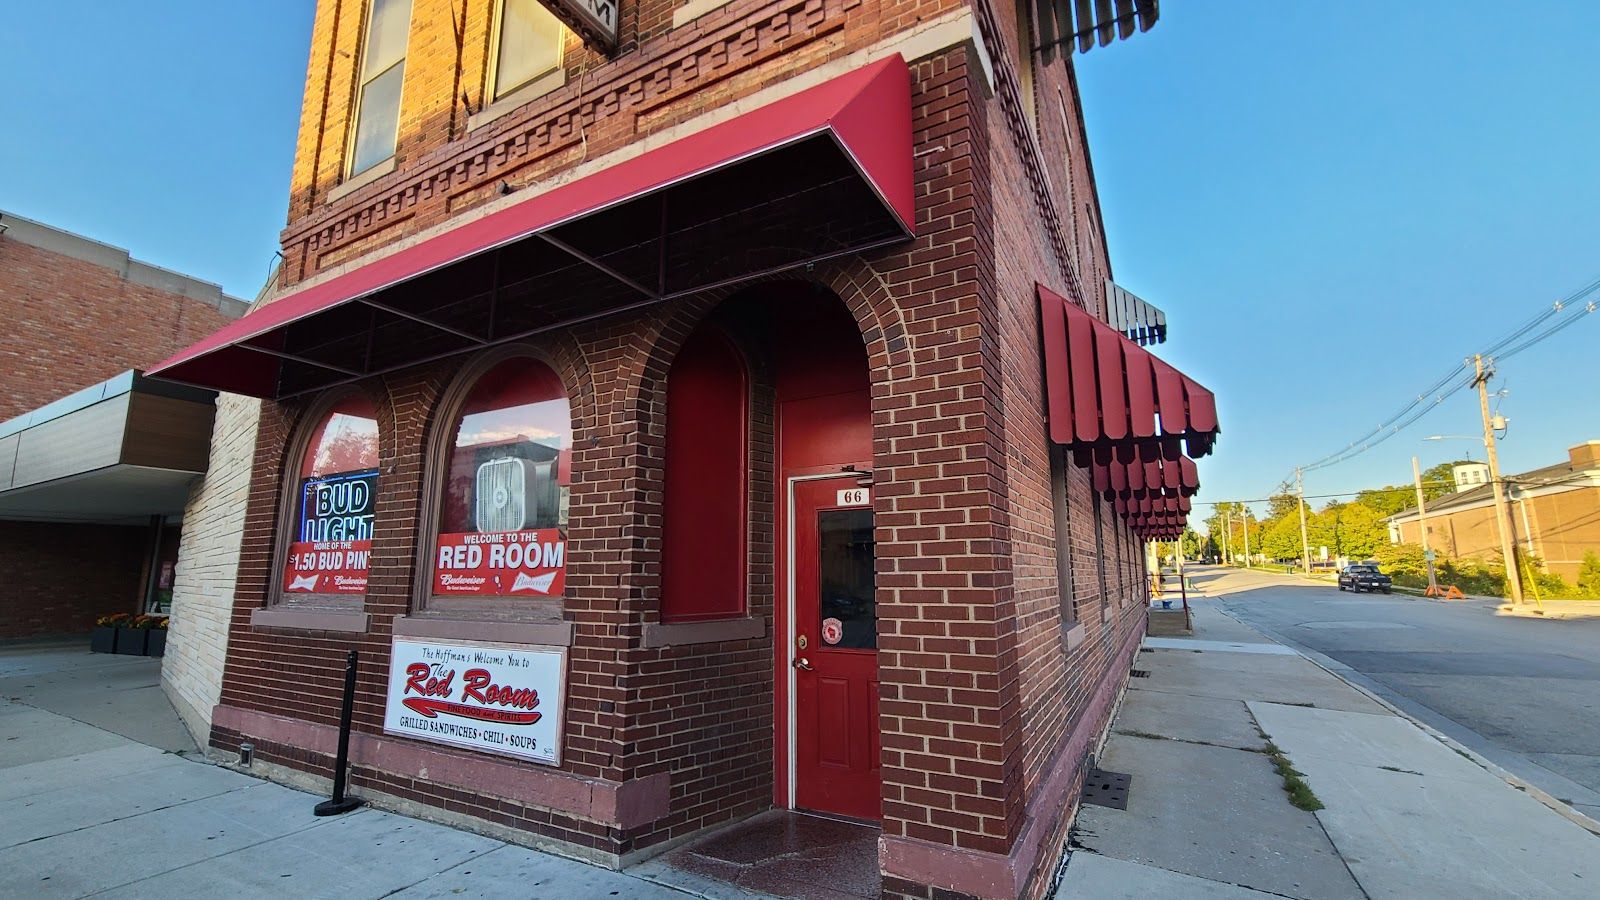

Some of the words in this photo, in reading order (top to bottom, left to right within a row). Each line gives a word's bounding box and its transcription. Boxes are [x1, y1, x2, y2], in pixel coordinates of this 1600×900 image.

[316, 480, 369, 517] BUD
[844, 490, 862, 503] 66
[306, 514, 375, 543] LIGHT
[463, 533, 504, 545] WELCOME
[506, 532, 518, 543] TO
[520, 532, 538, 542] THE
[313, 542, 331, 550] HOME
[340, 541, 352, 549] THE
[438, 545, 483, 569] RED
[489, 542, 565, 569] ROOM
[318, 551, 344, 571] BUD
[345, 551, 371, 570] PIN
[422, 647, 434, 660] The
[474, 652, 504, 666] Welcome
[508, 653, 520, 667] You
[522, 657, 530, 668] to
[430, 663, 448, 677] The
[404, 662, 456, 698] Red
[461, 668, 540, 711] Room
[462, 705, 481, 716] FOOD
[497, 712, 521, 721] SPIRITS
[400, 716, 429, 731] GRILLED
[429, 721, 477, 740] SANDWICHES
[483, 730, 504, 745] CHILI
[509, 735, 537, 750] SOUPS
